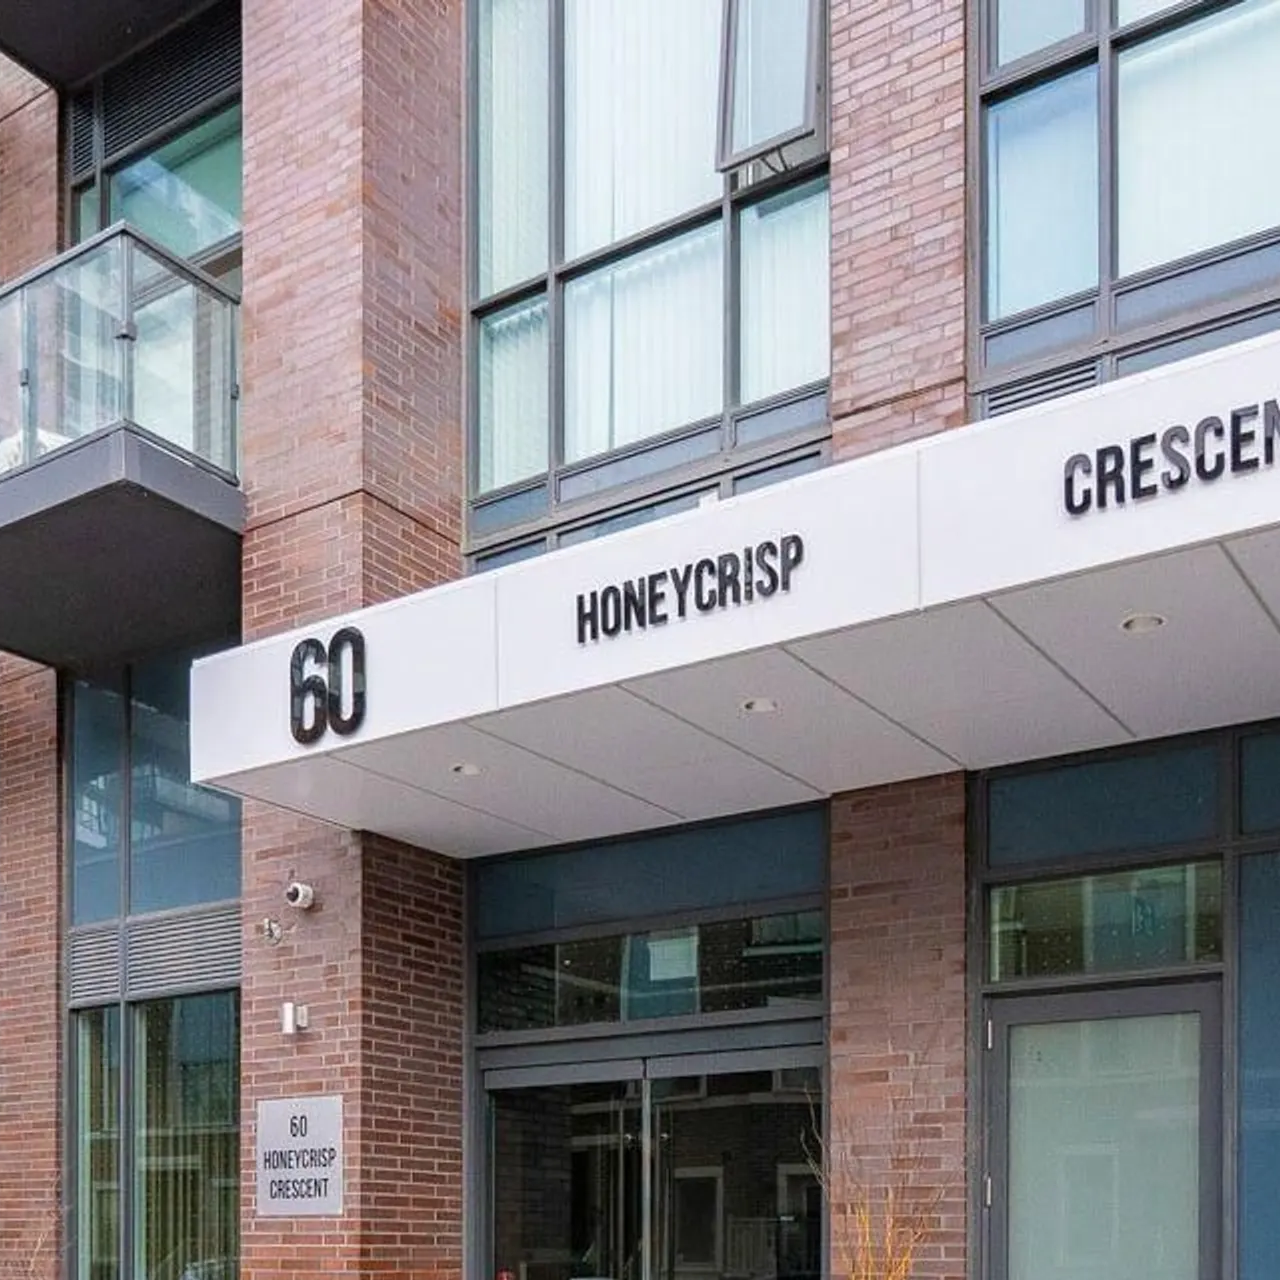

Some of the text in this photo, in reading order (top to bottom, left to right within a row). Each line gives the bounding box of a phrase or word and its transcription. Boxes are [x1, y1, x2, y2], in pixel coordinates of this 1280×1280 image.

[290, 626, 367, 745] 60
[576, 534, 804, 644] HONEYCRISP
[289, 1115, 308, 1138] 60
[263, 1147, 338, 1170] HONEYCRISP
[269, 1177, 330, 1200] CRESCENT
